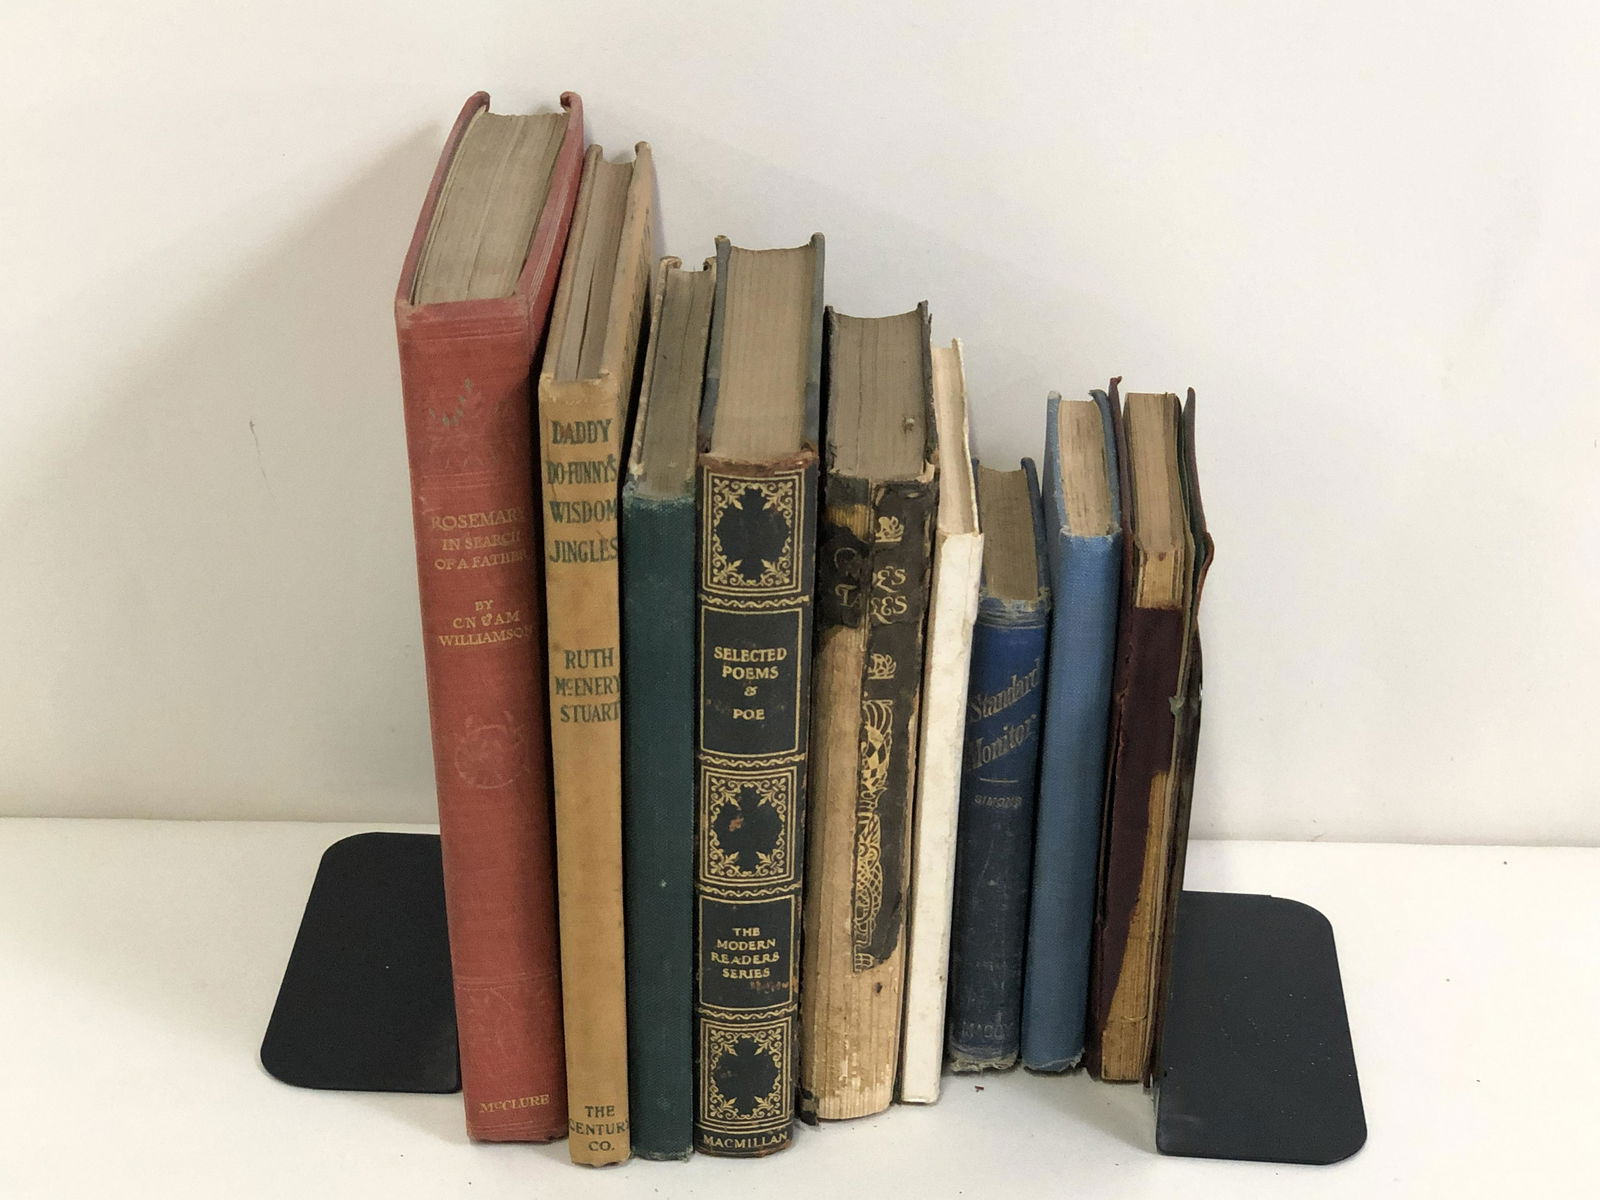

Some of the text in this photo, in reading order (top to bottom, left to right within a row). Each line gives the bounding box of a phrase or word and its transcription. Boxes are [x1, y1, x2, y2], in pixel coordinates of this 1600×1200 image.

[551, 418, 613, 445] DADDY
[431, 506, 525, 531] ROSEMARY
[549, 499, 618, 524] WISDOM
[442, 531, 521, 550] IN SEARCH
[550, 535, 618, 563] JINGLES
[434, 558, 455, 570] OF
[457, 558, 469, 569] A
[475, 600, 494, 611] BY
[438, 624, 532, 647] WILLIAMSON
[563, 647, 614, 670] RUTH
[713, 646, 787, 663] SELECTED
[722, 664, 779, 680] POEMS
[744, 686, 758, 697] &
[560, 699, 621, 723] STUART
[733, 708, 766, 720] POE
[732, 927, 760, 937] THE
[716, 939, 776, 951] MODERN
[711, 951, 780, 965] READERS
[722, 967, 770, 979] SERIES
[585, 1105, 616, 1118] THE
[588, 1141, 615, 1152] CO.
[703, 1131, 788, 1149] MACMILLAN
